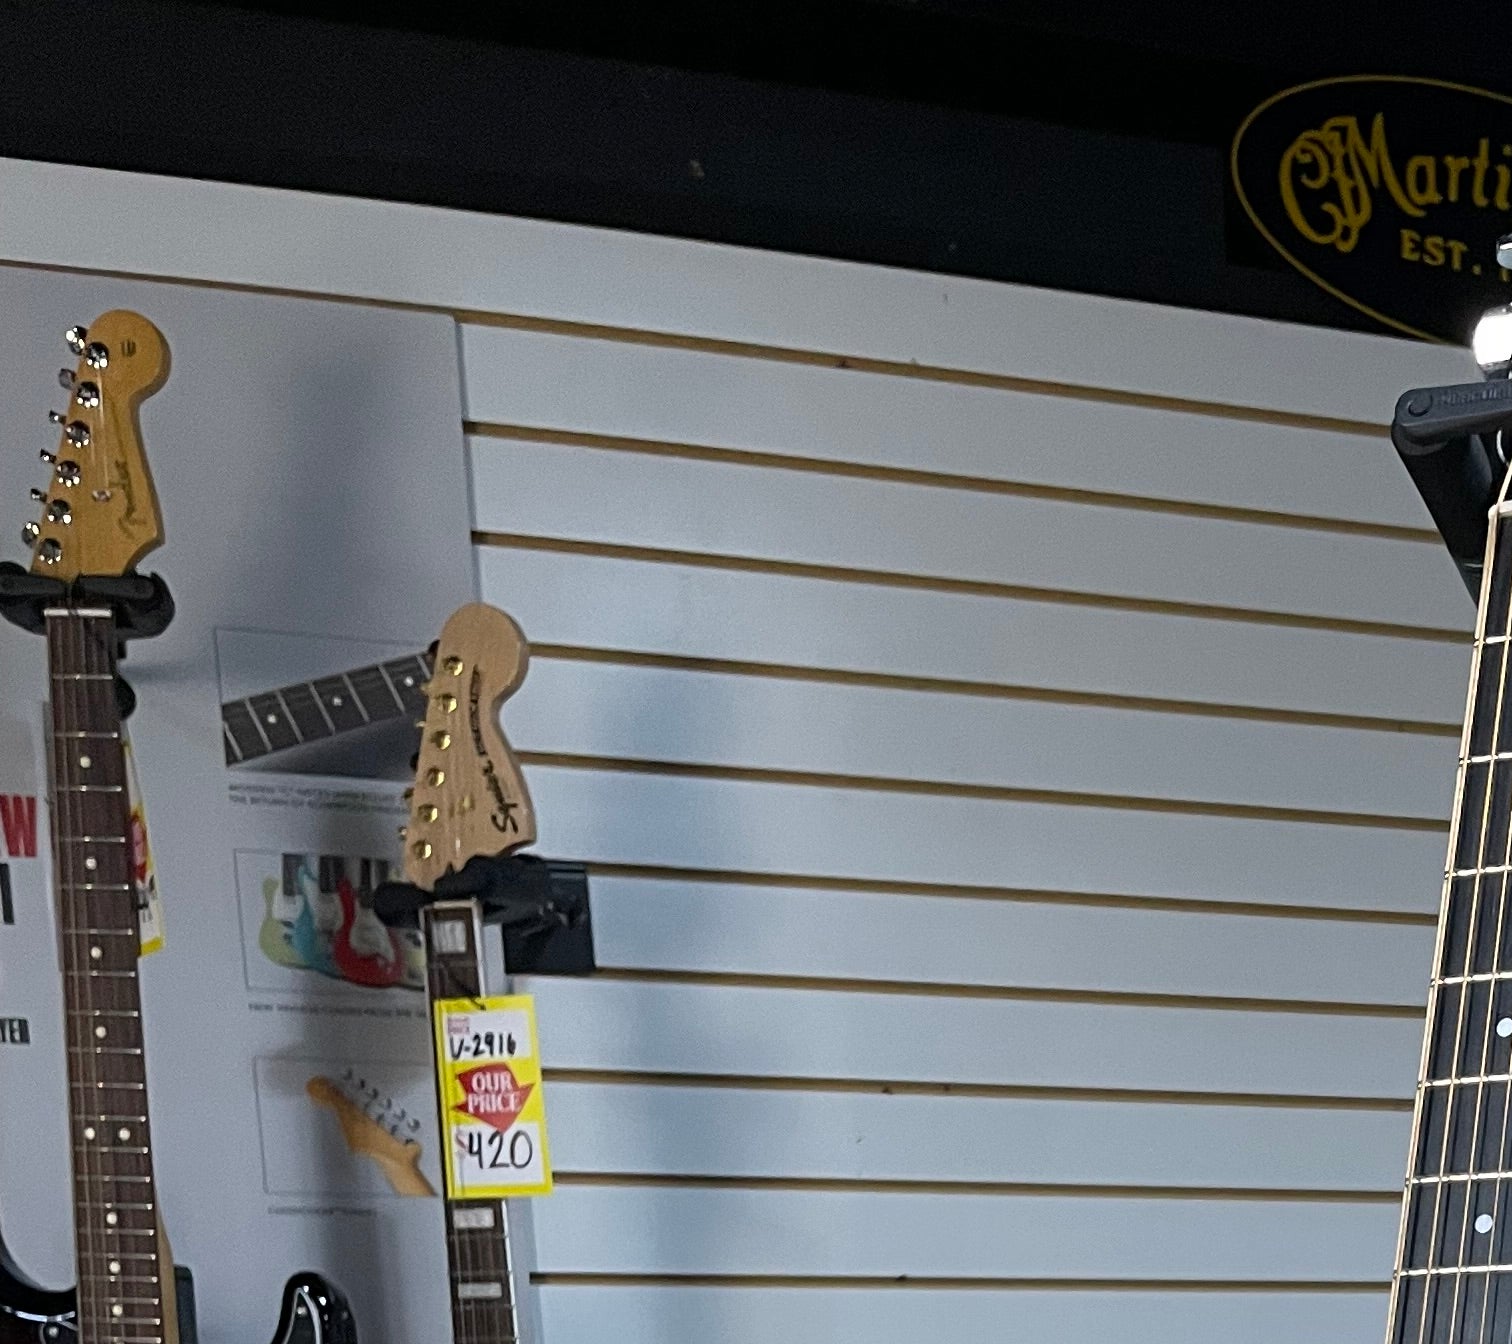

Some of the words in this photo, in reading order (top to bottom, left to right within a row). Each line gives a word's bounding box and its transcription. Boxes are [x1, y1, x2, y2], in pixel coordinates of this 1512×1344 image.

[1400, 228, 1482, 275] EST.
[471, 1071, 513, 1092] OUR
[467, 1092, 521, 1114] PRICE
